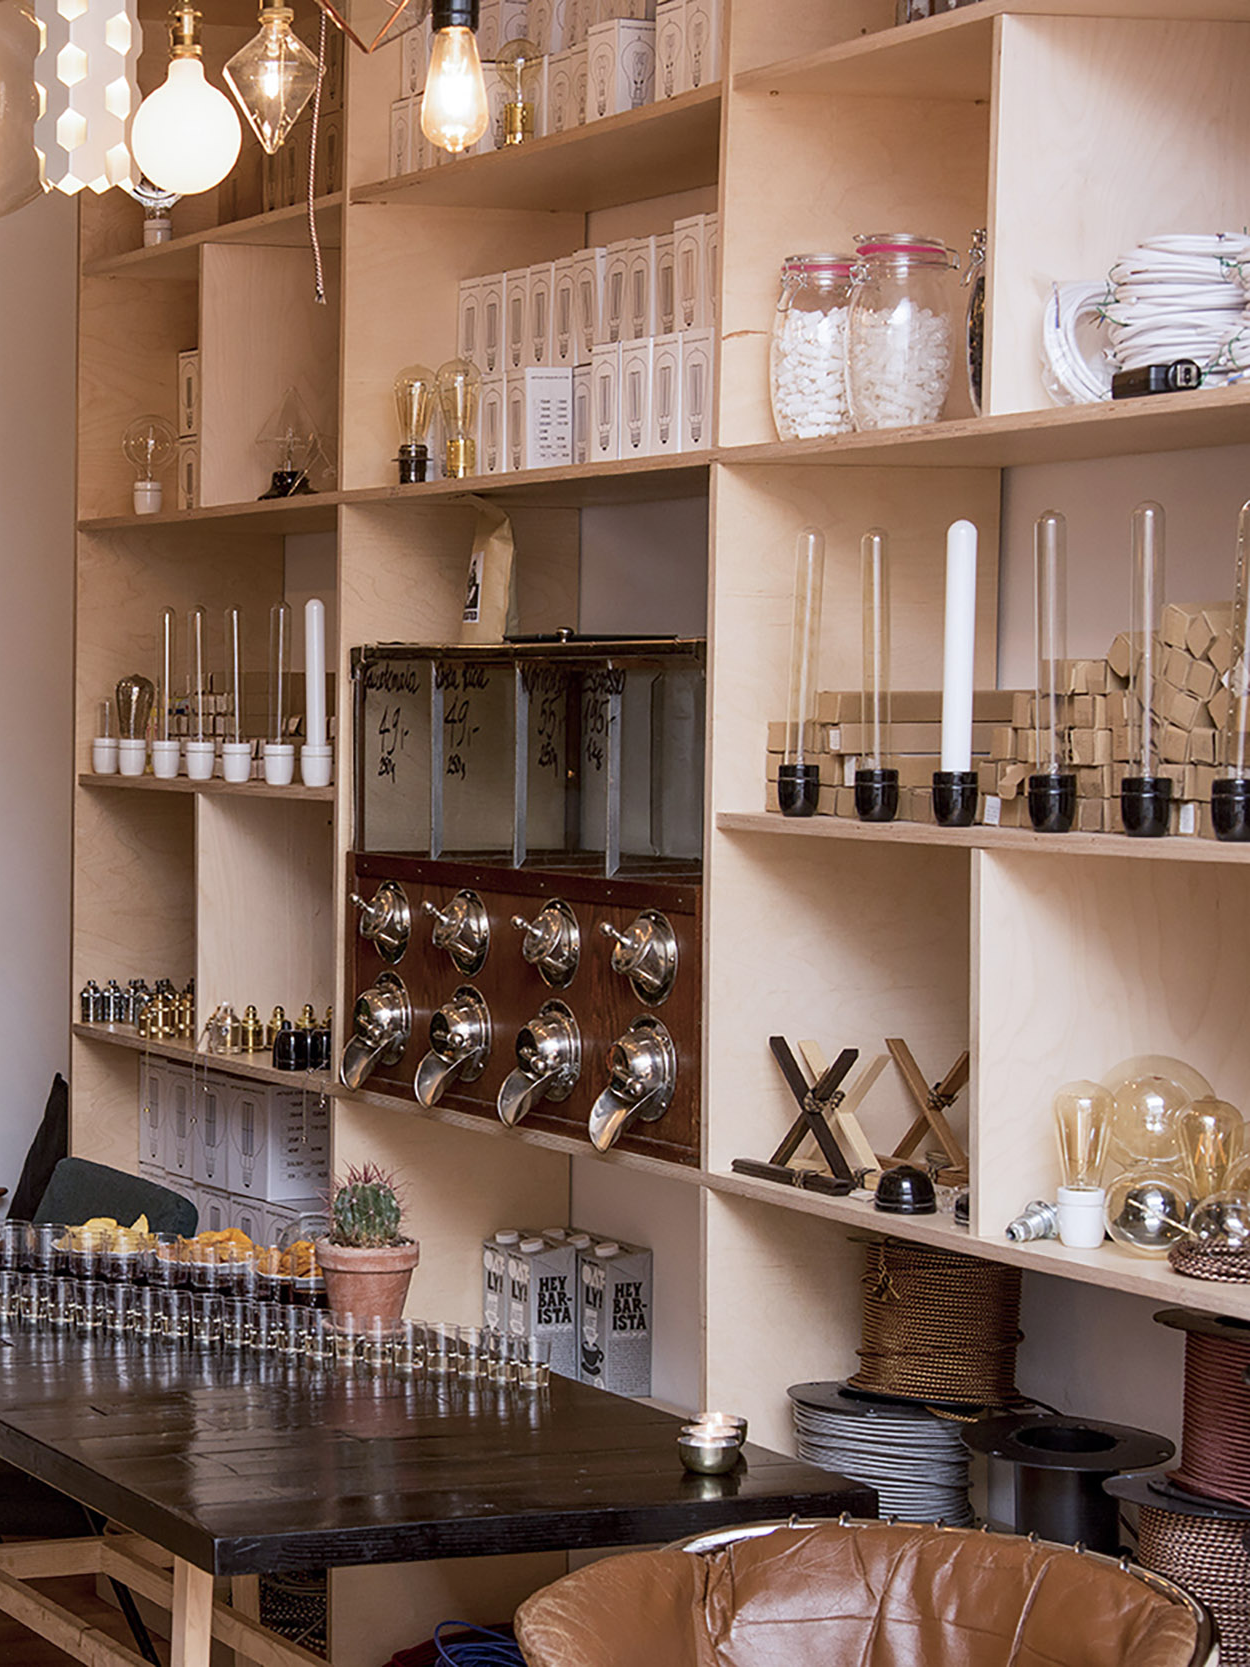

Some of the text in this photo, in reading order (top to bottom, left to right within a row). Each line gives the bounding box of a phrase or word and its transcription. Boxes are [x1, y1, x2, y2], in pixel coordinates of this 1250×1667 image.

[539, 1275, 568, 1292] HEY
[615, 1281, 643, 1298] HEY
[538, 1291, 573, 1308] BAR-
[613, 1298, 648, 1314] BAR-
[538, 1306, 573, 1324] ISTA
[613, 1313, 647, 1331] ISTA
